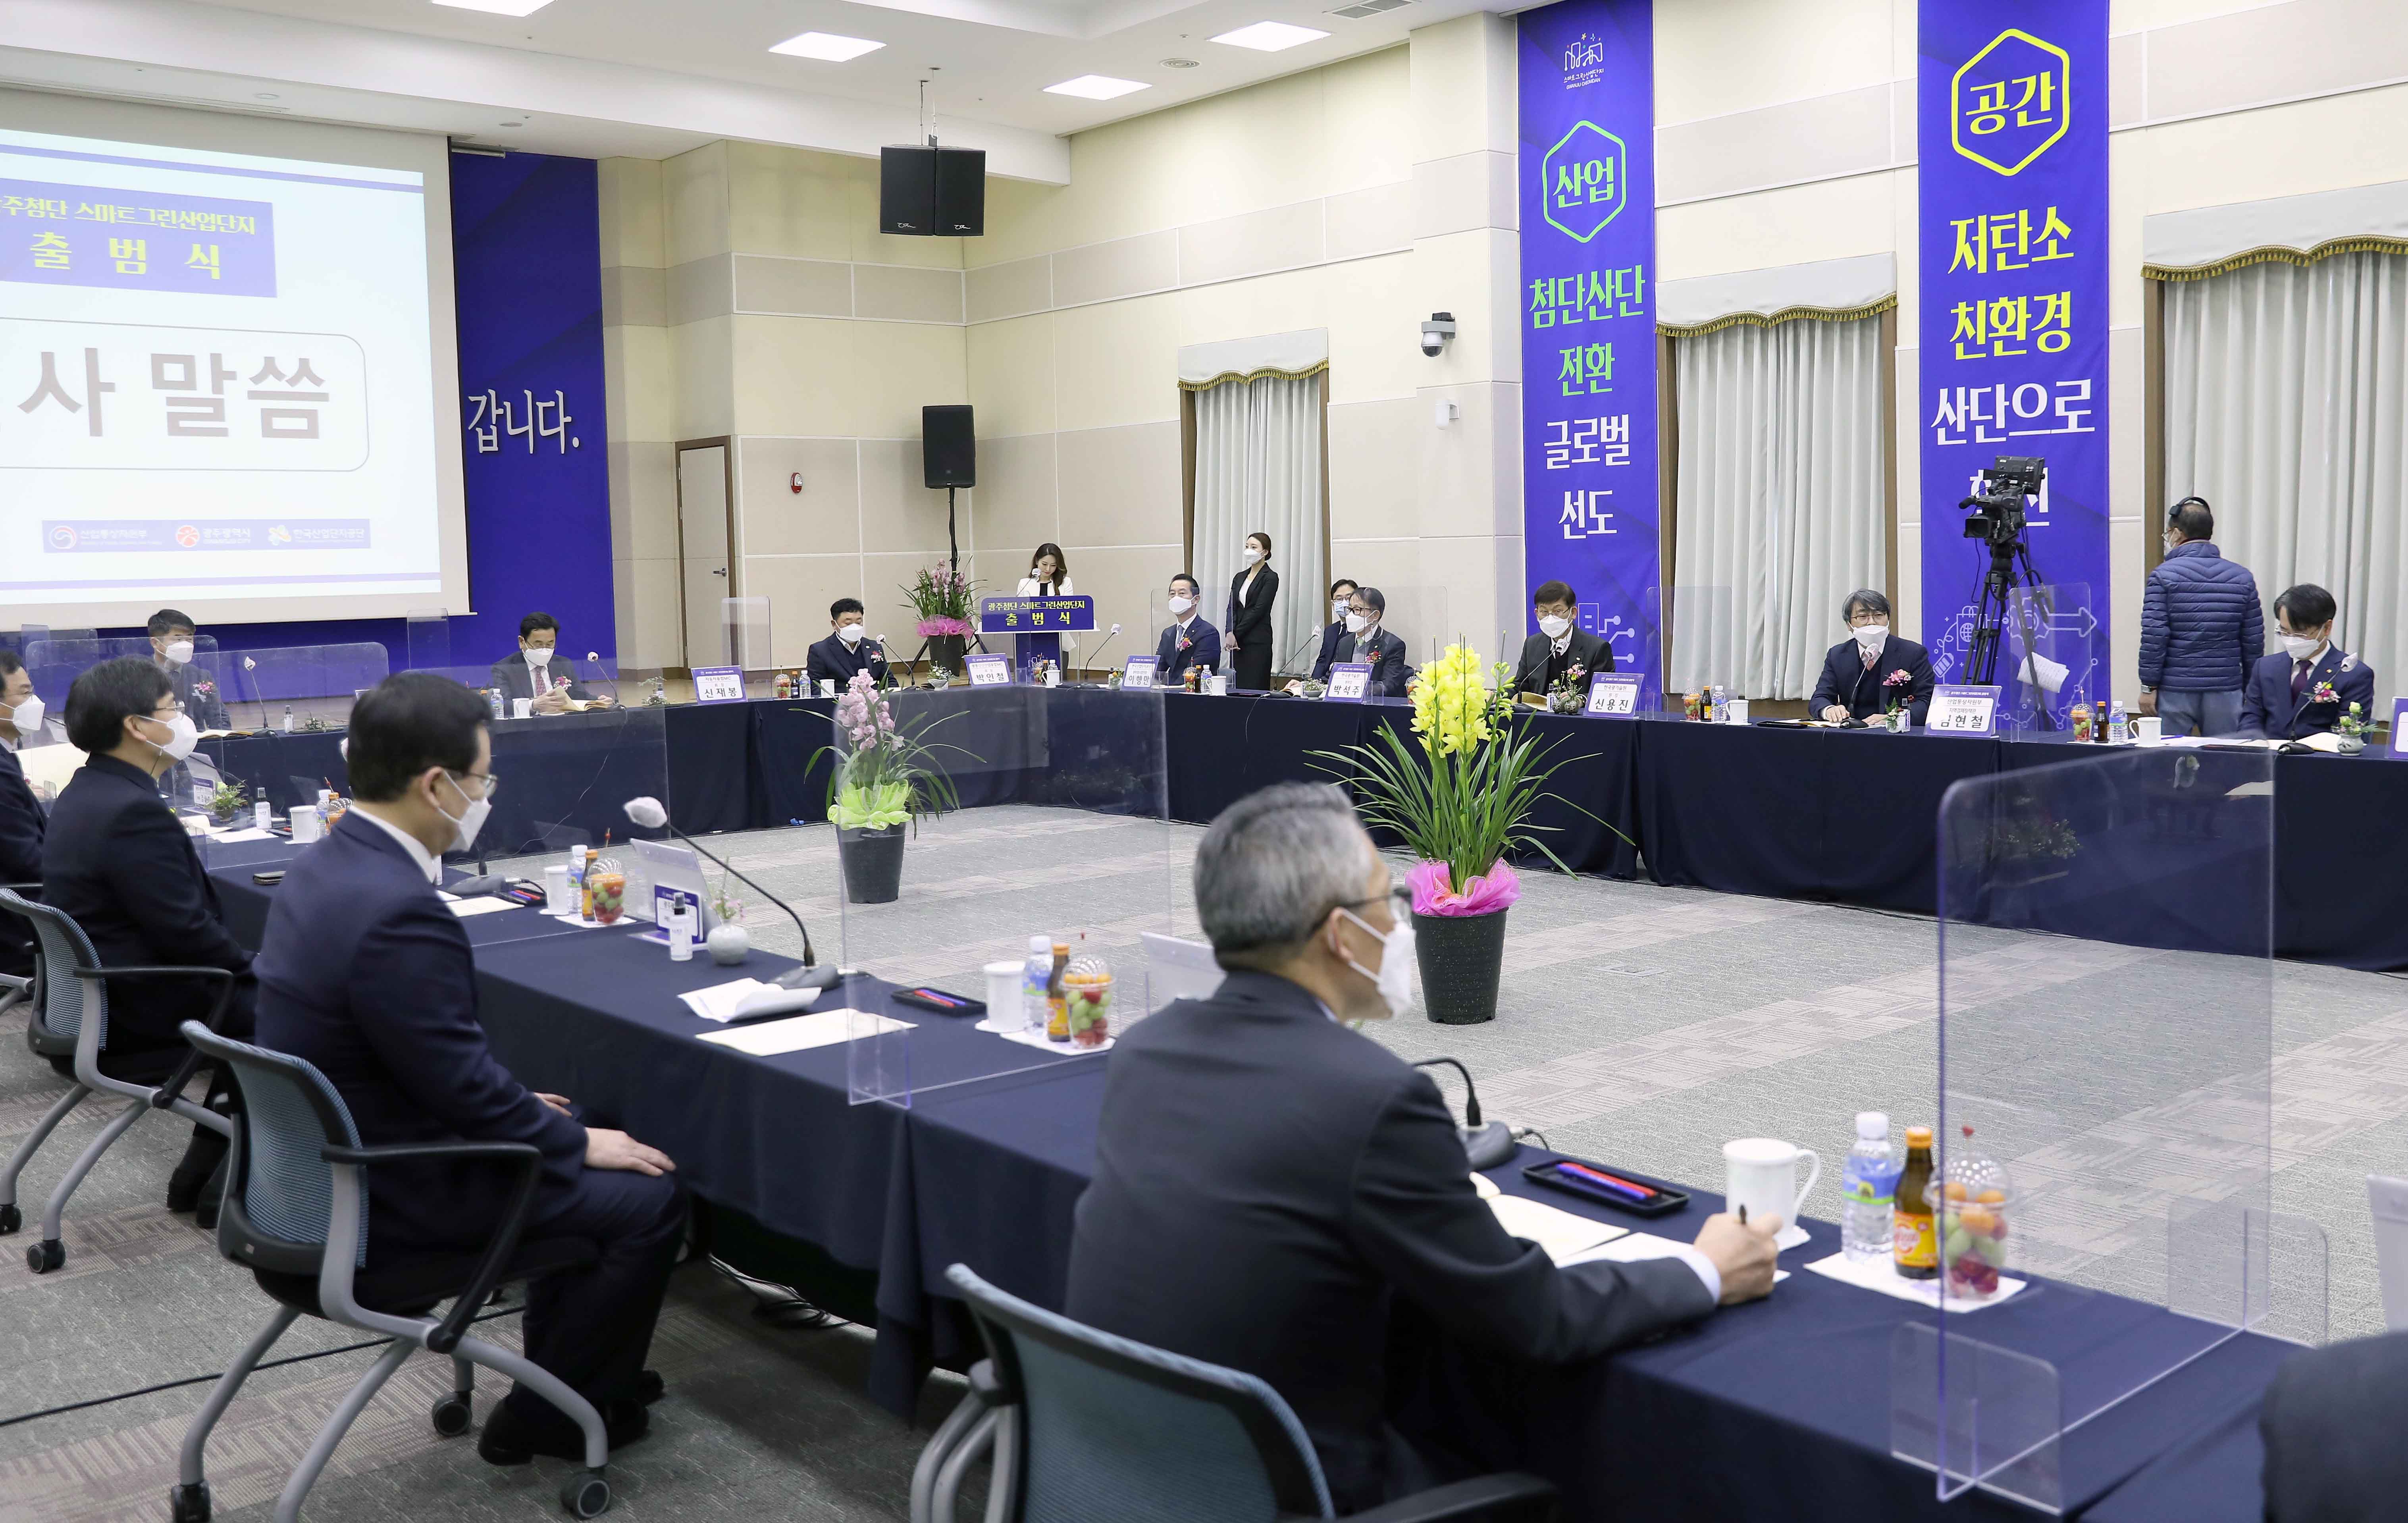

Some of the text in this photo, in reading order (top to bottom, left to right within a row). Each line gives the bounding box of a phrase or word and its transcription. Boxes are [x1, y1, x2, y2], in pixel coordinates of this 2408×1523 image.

[1966, 71, 2055, 135] 공간
[1553, 156, 1614, 208] 산업
[0, 195, 255, 235] 주첨단 스마트그린산업단지
[1948, 206, 2074, 274] 저탄소
[1529, 264, 1645, 329] 첨단산단
[1950, 291, 2071, 360] 친환경
[150, 353, 329, 439] 말씀
[1557, 342, 1616, 396] 전환
[468, 389, 580, 454] 갑니다.
[1543, 414, 1630, 470] 글로벌
[1930, 378, 2095, 445] 산단으로
[1558, 489, 1617, 540] 선도
[988, 600, 1085, 611] 광주첨단 스마트그린산업단지
